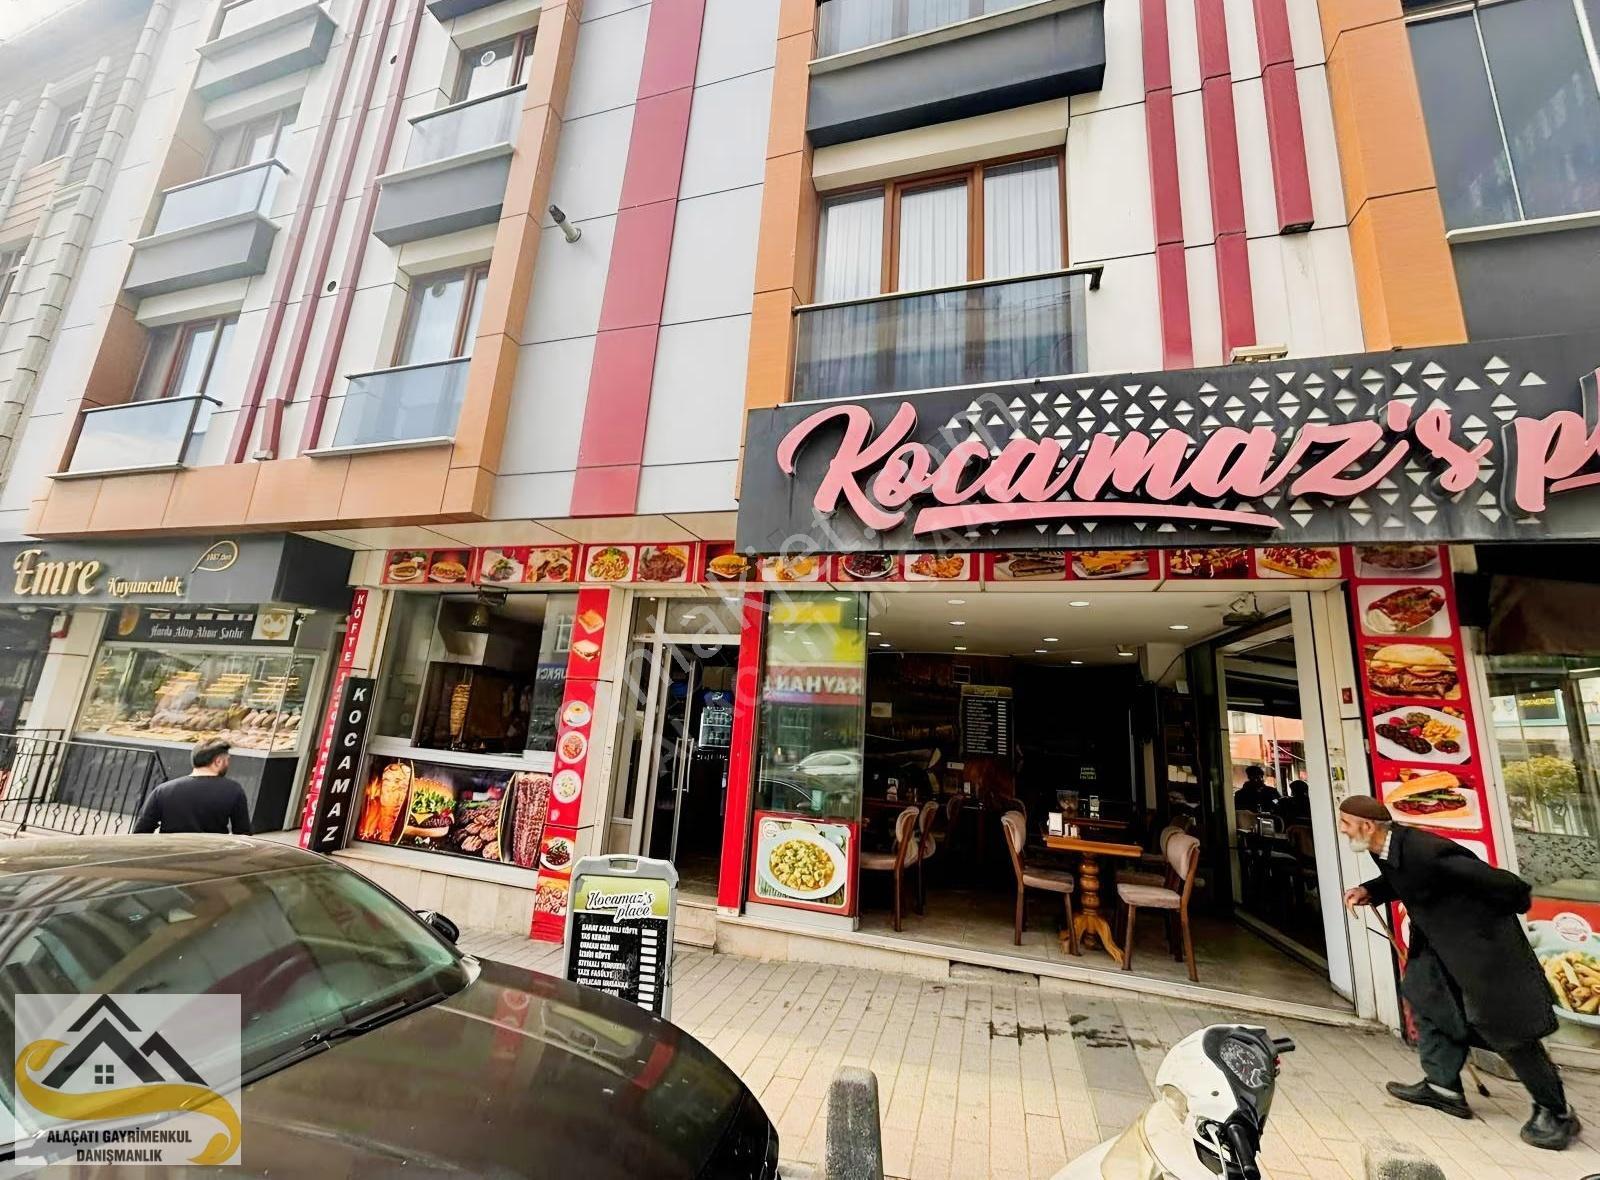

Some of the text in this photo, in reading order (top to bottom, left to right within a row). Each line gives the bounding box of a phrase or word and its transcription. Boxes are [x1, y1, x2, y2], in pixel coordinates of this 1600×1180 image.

[776, 400, 1493, 531] Kocamaz's
[13, 549, 184, 598] Emre Kuyumculuk
[344, 594, 365, 662] KÖFTE
[322, 688, 367, 842] KOCAMAZ
[587, 891, 653, 907] Kocamaz's
[615, 903, 651, 920] place
